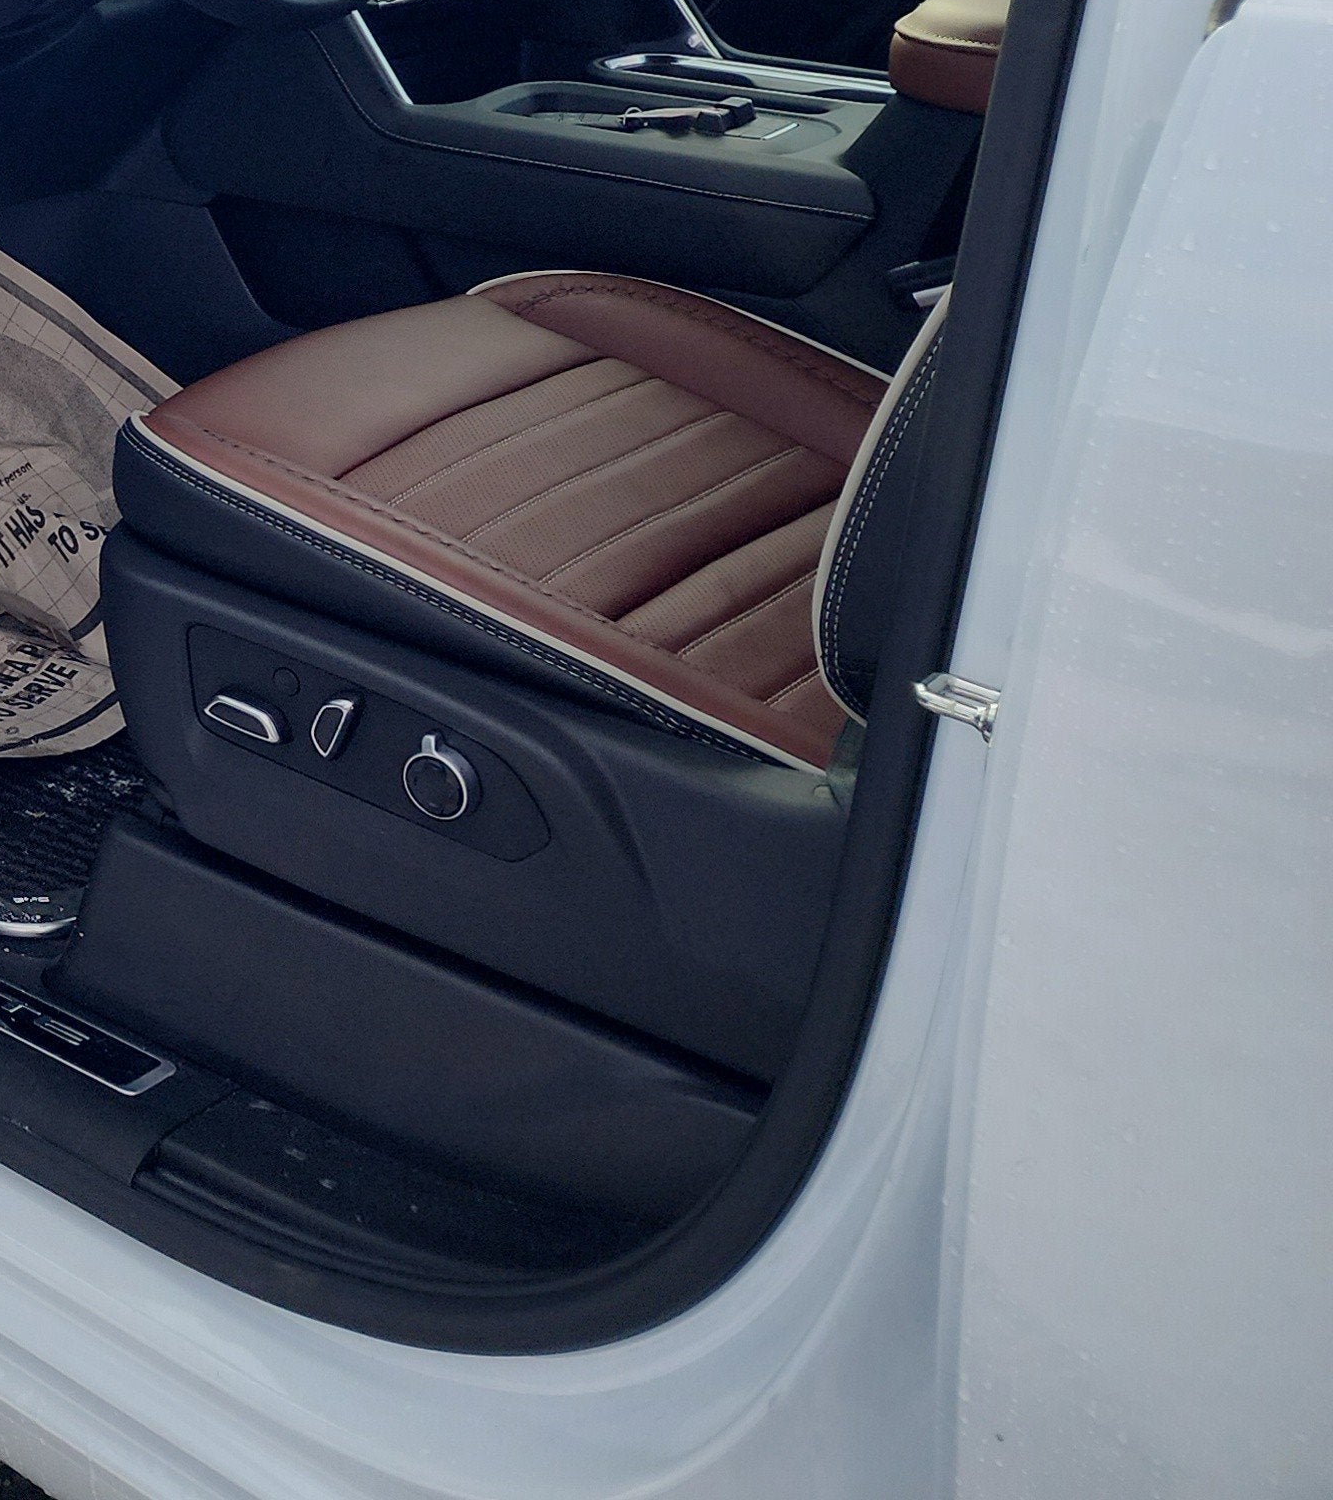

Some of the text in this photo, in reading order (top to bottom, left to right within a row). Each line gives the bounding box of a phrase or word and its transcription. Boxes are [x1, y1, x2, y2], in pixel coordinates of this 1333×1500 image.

[4, 462, 33, 488] person
[4, 505, 46, 549] HAS
[48, 525, 79, 563] TO
[4, 659, 36, 674] A
[5, 662, 80, 710] SERVE
